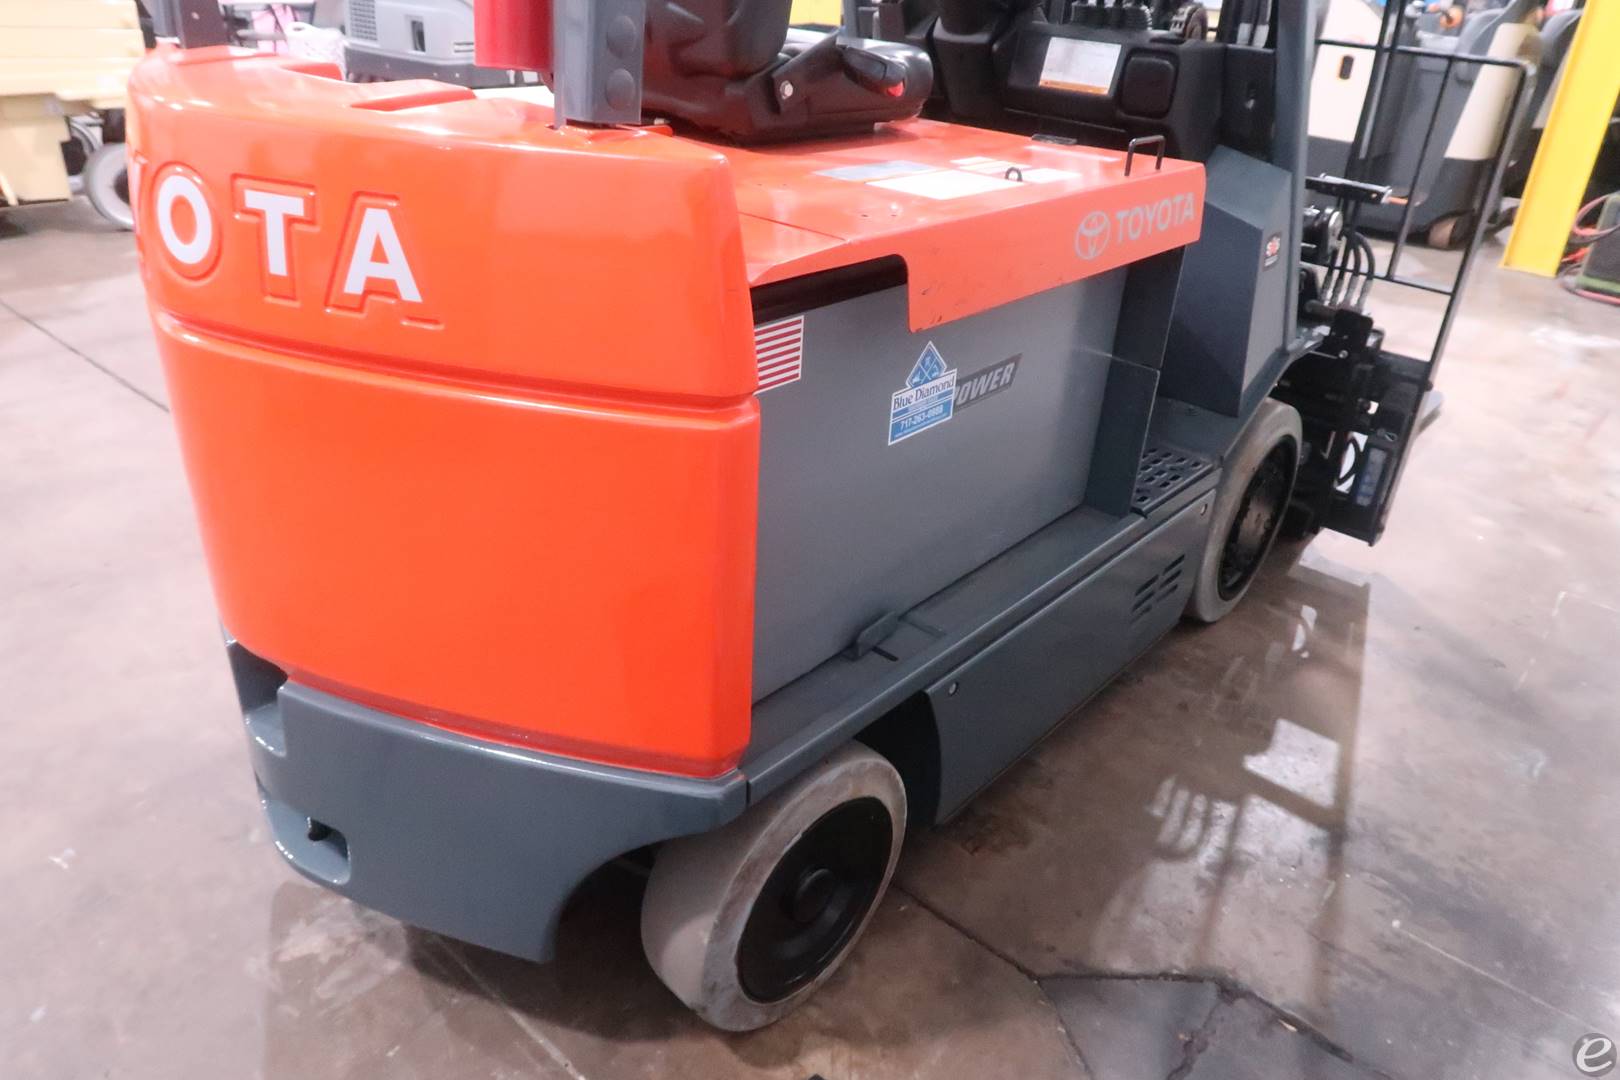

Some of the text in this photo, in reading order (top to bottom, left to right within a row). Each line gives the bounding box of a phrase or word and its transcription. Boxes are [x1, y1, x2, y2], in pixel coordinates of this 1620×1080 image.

[129, 153, 424, 304] OTA
[1115, 192, 1195, 243] TOYOTA
[893, 394, 914, 412] Blue
[914, 374, 956, 401] Diamond
